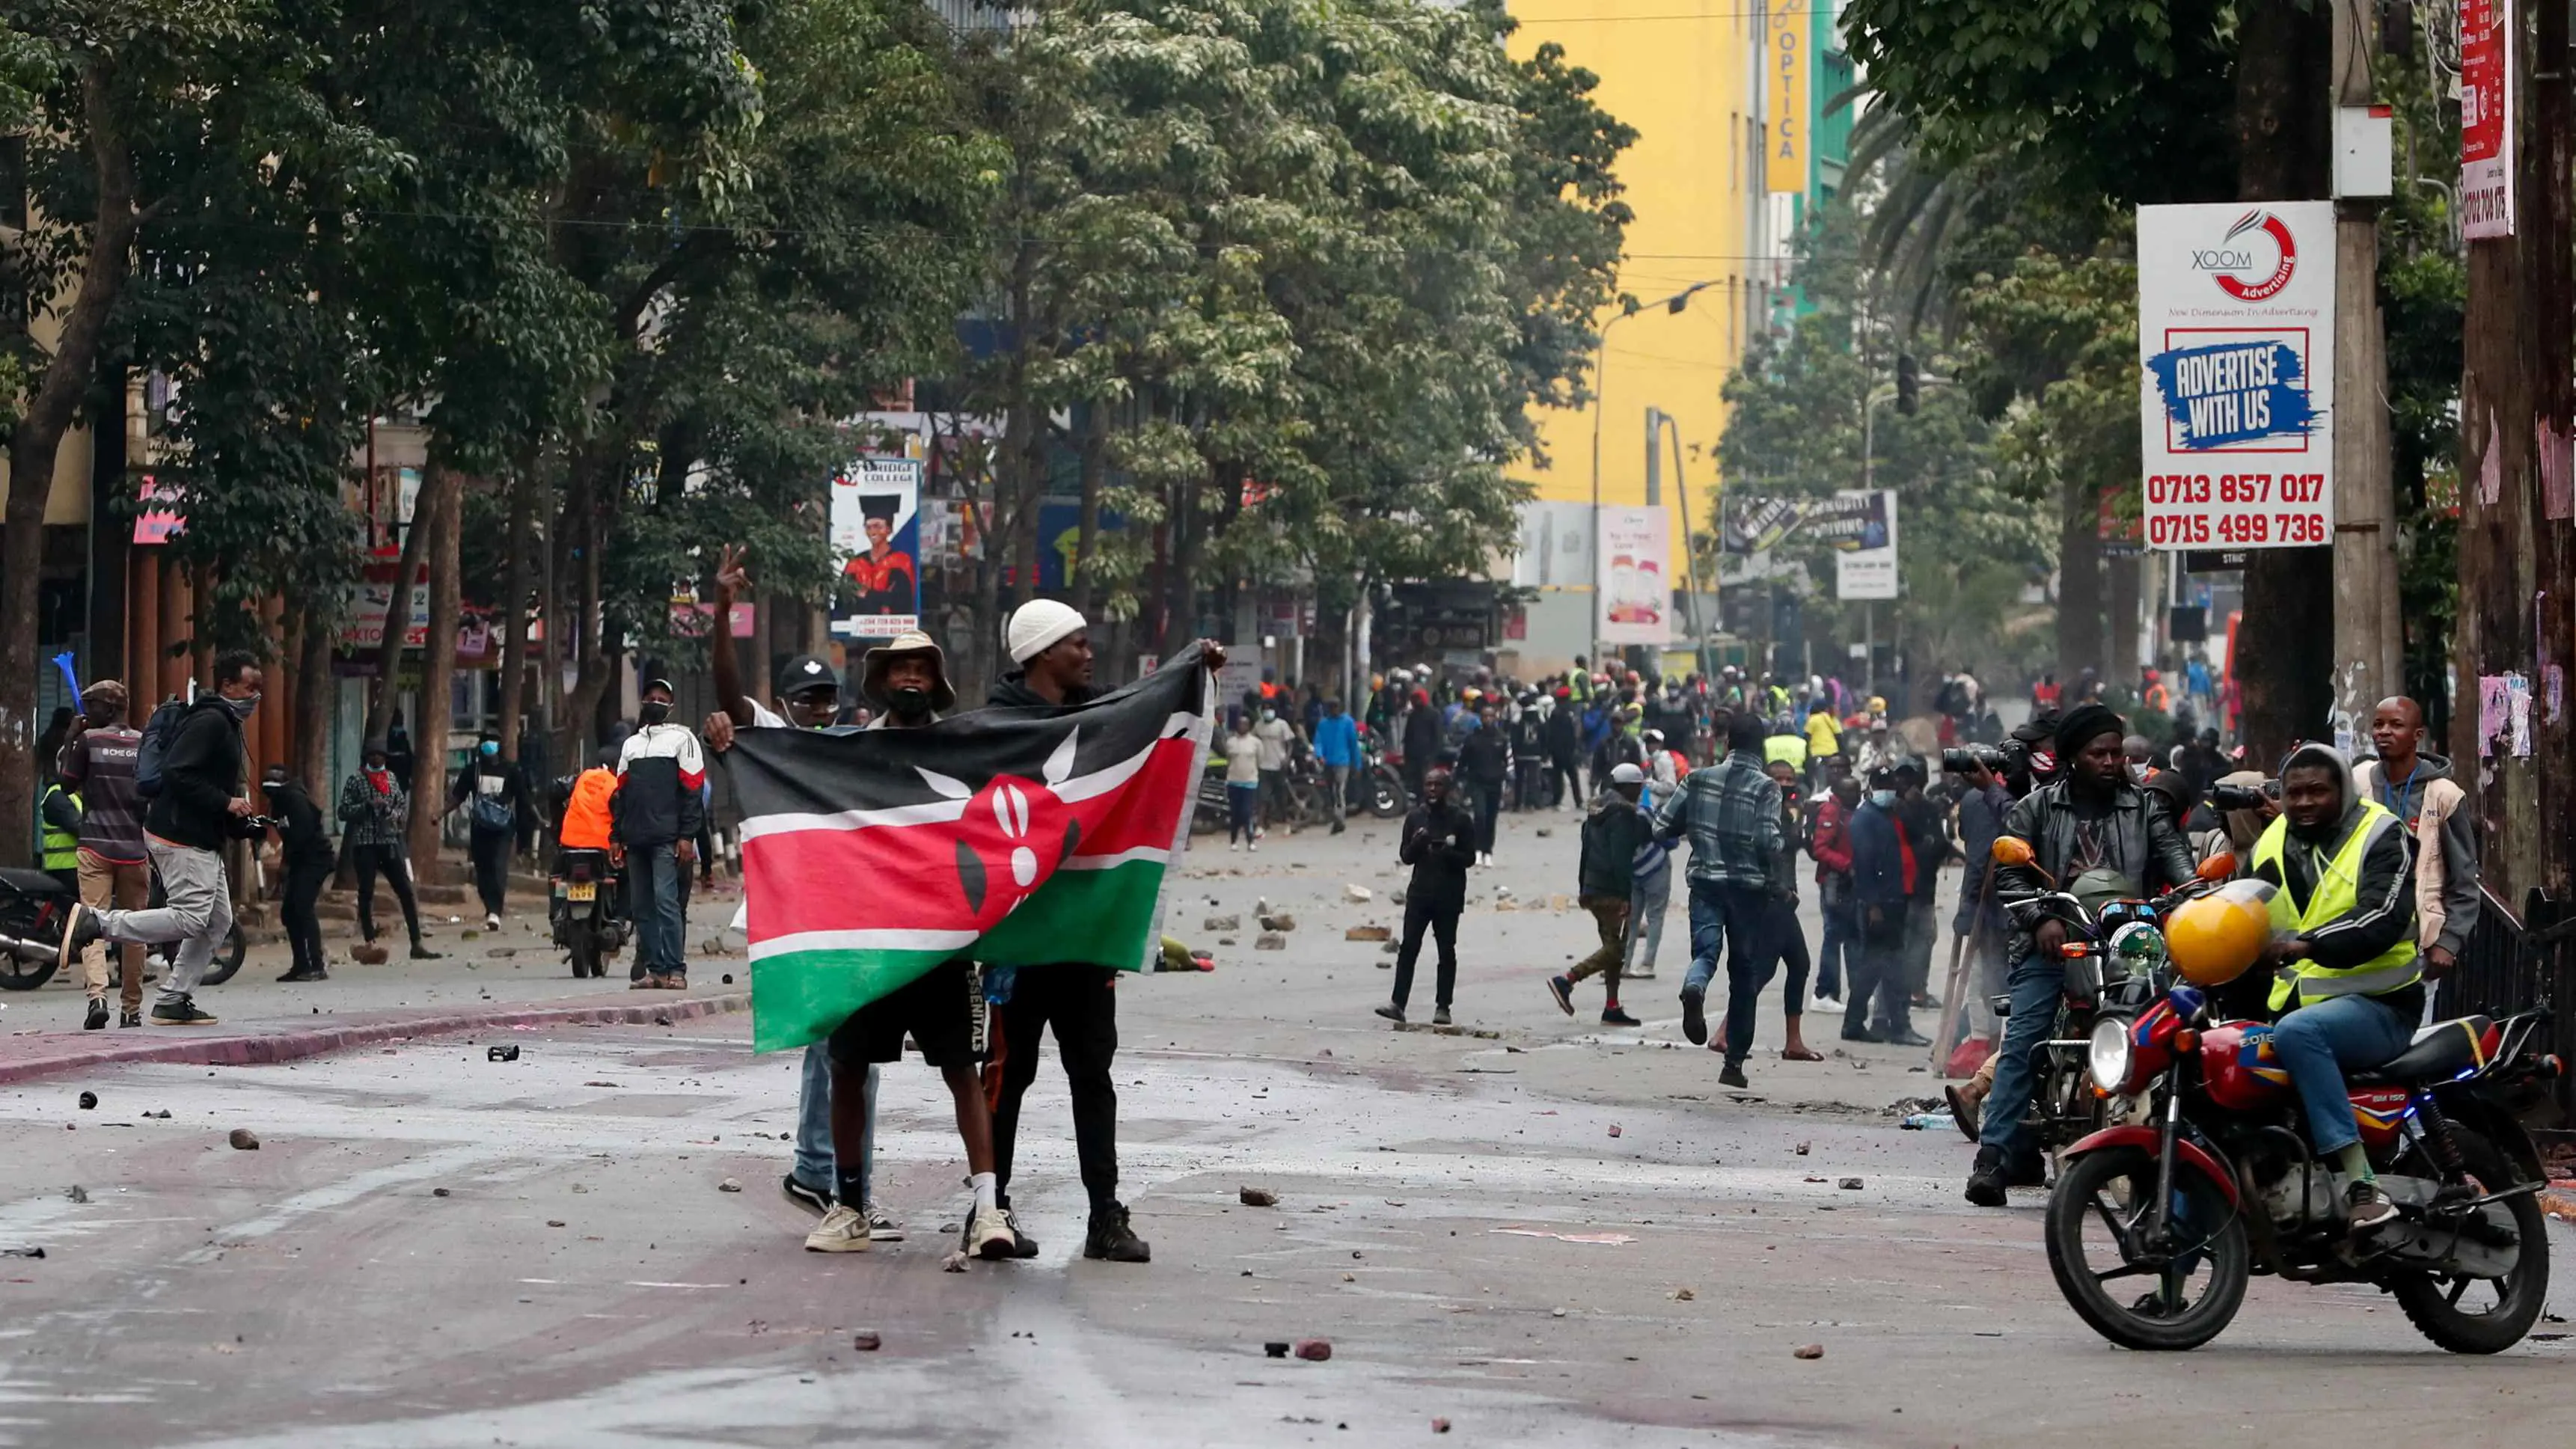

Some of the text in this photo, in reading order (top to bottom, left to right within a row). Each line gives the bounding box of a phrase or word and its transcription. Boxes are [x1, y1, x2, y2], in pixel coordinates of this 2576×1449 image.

[1779, 32, 1796, 159] OPTICA
[2465, 190, 2480, 225] 0702
[2191, 250, 2252, 270] XOOM
[2241, 256, 2296, 298] Advertising
[2191, 307, 2244, 317] Dimension
[2260, 307, 2319, 317] Advertising
[2176, 345, 2278, 398] ADVERTISE
[2188, 388, 2271, 438] WITH US
[2148, 474, 2324, 503] 0713 857 017
[2150, 513, 2325, 544] 0715 499 736
[2238, 1032, 2275, 1048] BOXE
